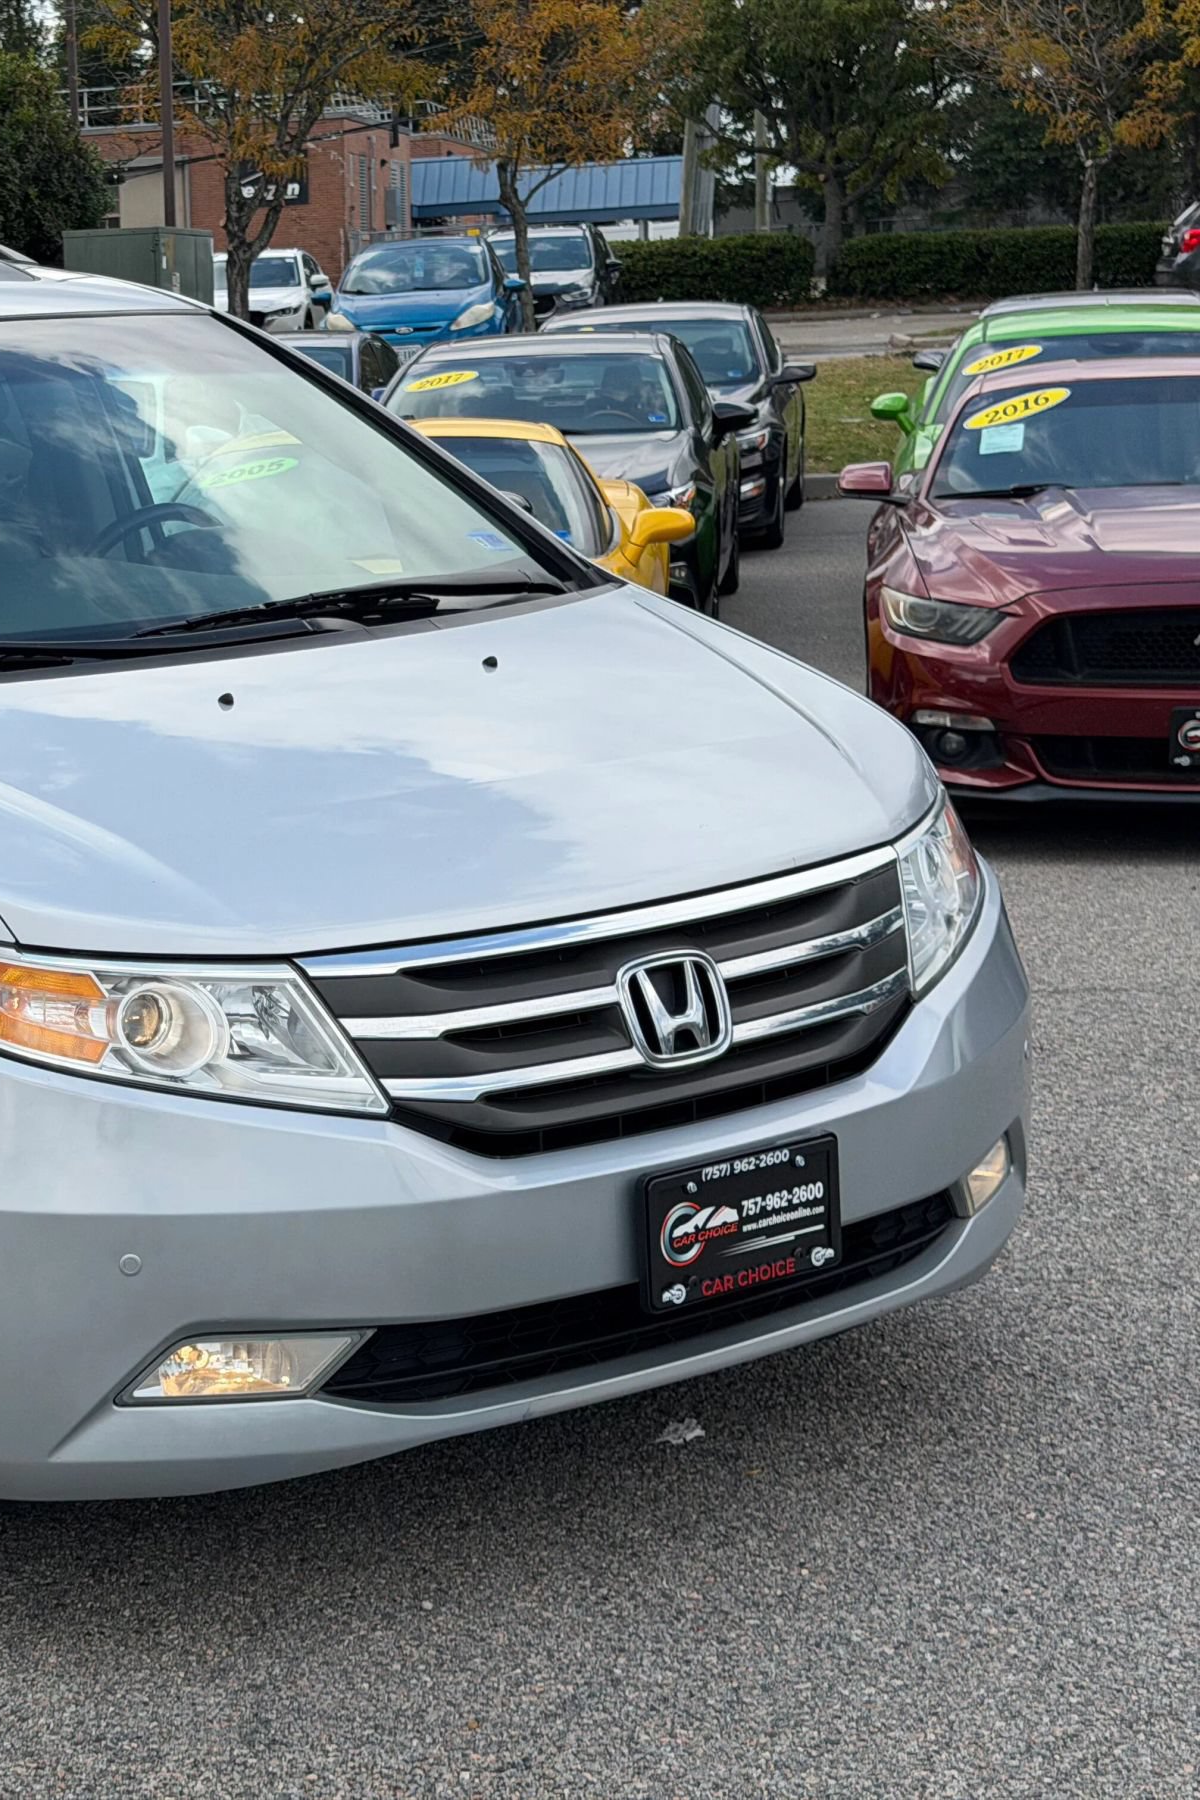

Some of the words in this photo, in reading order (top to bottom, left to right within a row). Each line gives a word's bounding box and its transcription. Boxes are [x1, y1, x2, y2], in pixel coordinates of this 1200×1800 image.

[977, 348, 1026, 372] 2017
[419, 373, 465, 390] 2017
[984, 391, 1051, 425] 2016
[209, 458, 286, 487] 2005
[701, 1164, 731, 1183] (757)
[733, 1149, 790, 1175] 962-2600
[741, 1181, 824, 1217] 757-962-2600
[742, 1205, 825, 1233] www.carchoiceonline.com
[672, 1233, 696, 1249] CAR
[697, 1222, 740, 1242] CHOICE
[702, 1276, 734, 1296] CAR
[737, 1257, 796, 1288] CHOICE
